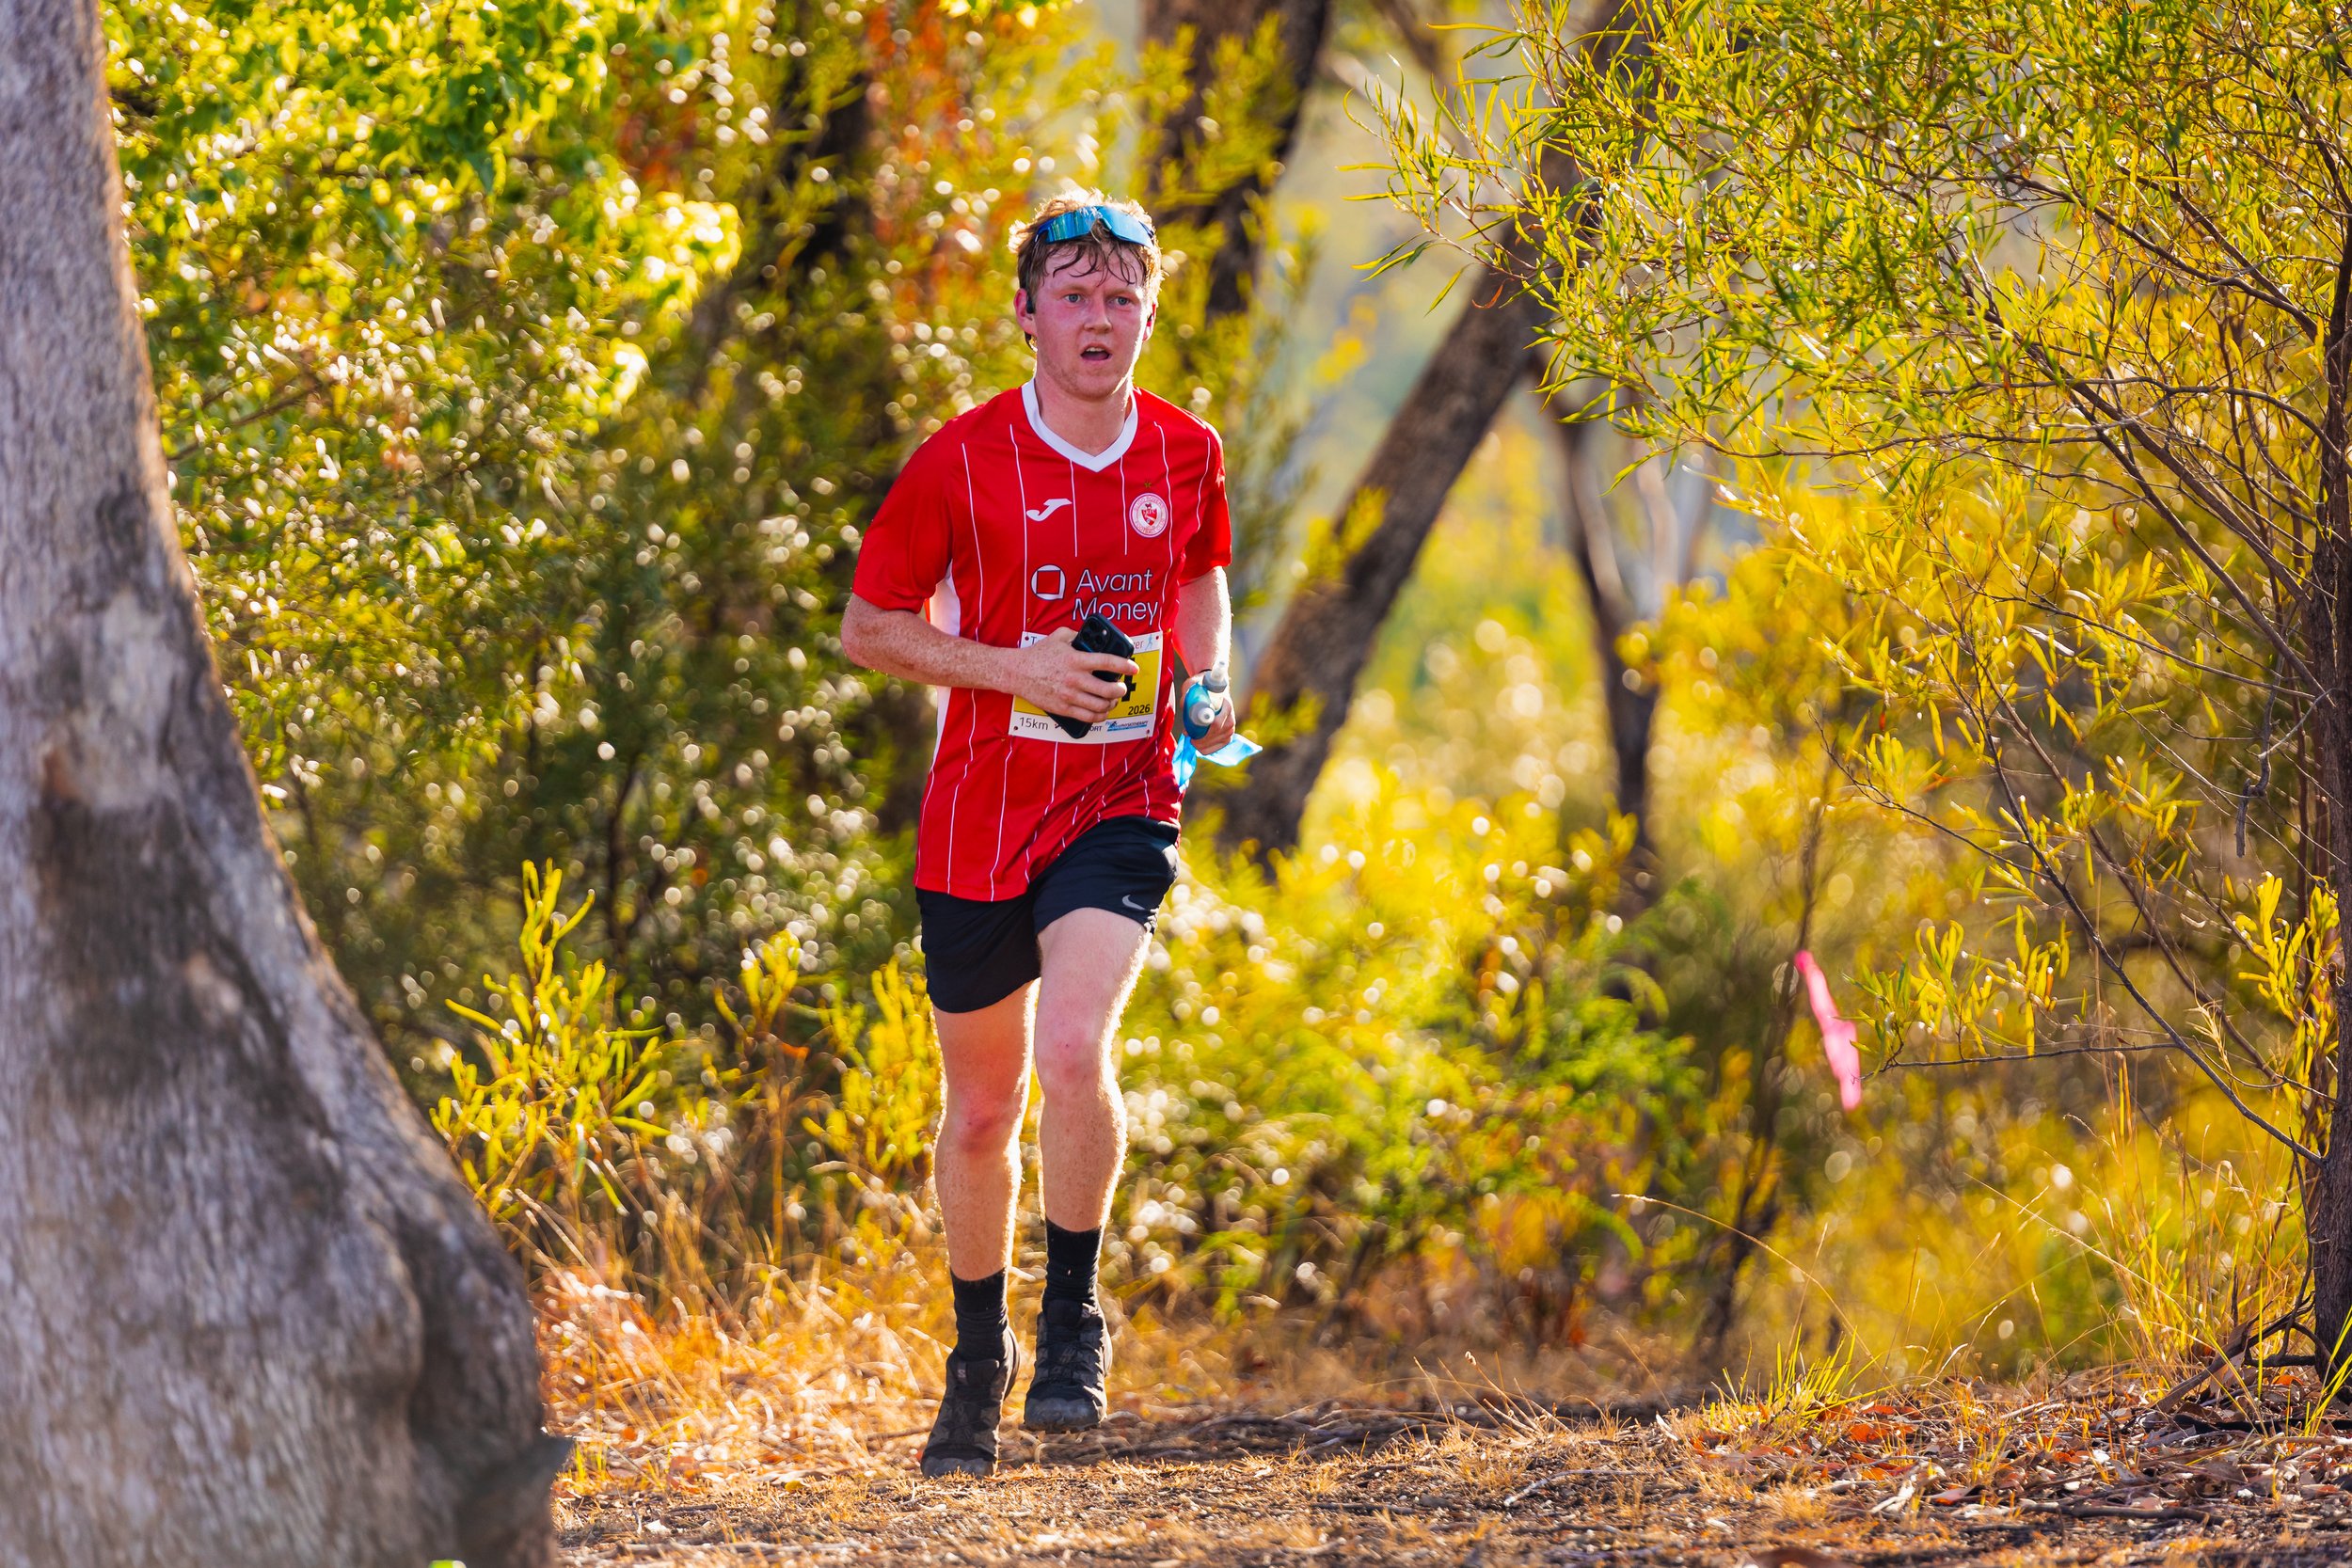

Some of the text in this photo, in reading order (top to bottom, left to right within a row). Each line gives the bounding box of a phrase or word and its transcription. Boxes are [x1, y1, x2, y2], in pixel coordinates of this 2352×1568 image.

[1075, 569, 1152, 593] Avant
[1073, 597, 1158, 626] Money
[1128, 704, 1151, 715] 2026
[1020, 717, 1048, 730] 15km
